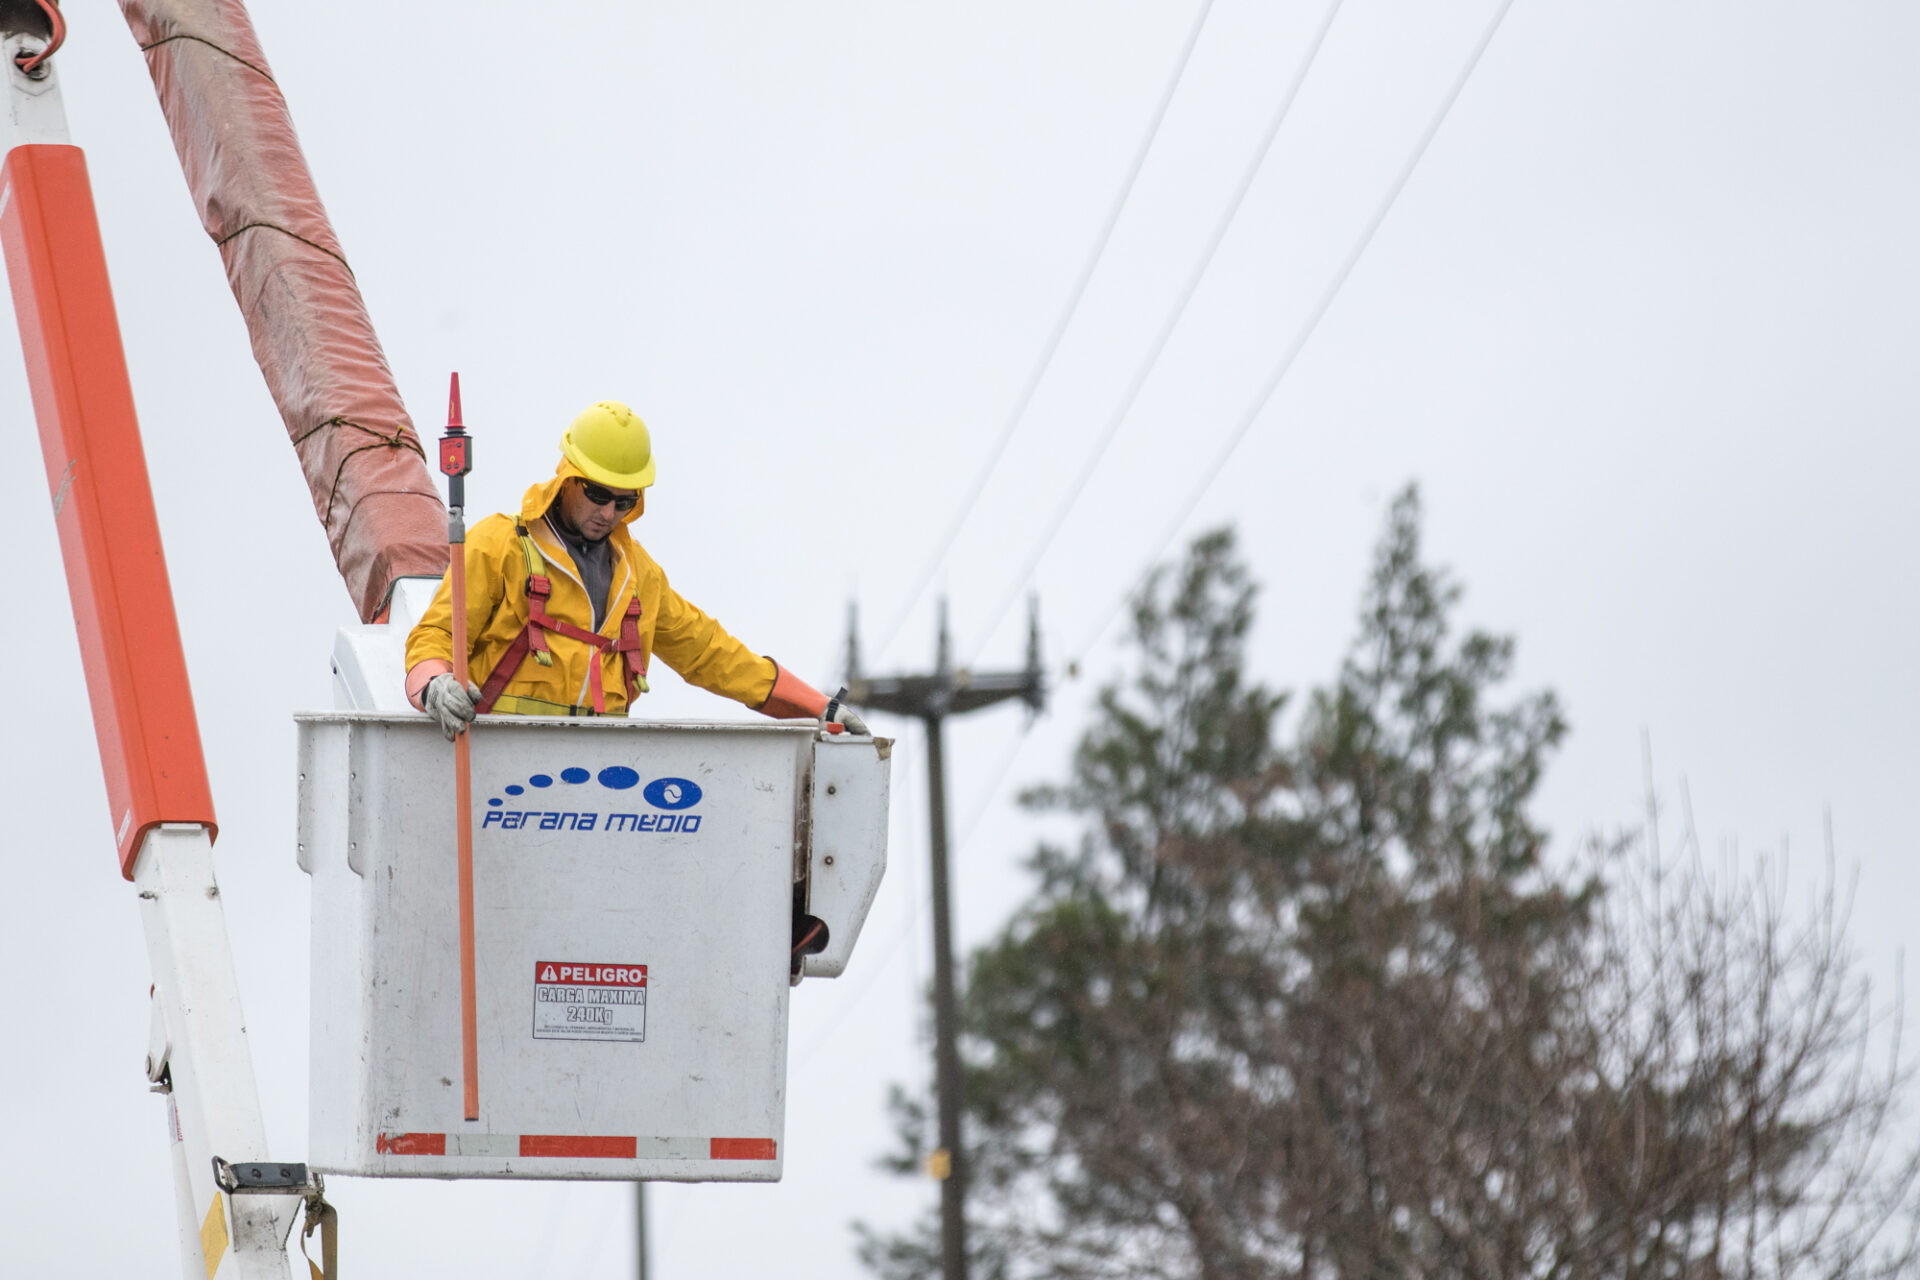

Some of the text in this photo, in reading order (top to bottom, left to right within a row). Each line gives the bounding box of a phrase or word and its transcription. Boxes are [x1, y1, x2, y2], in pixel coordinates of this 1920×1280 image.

[560, 966, 642, 983] PELIGRO
[538, 987, 645, 1005] CARGA MAXIMA
[567, 1006, 613, 1025] 240Kg
